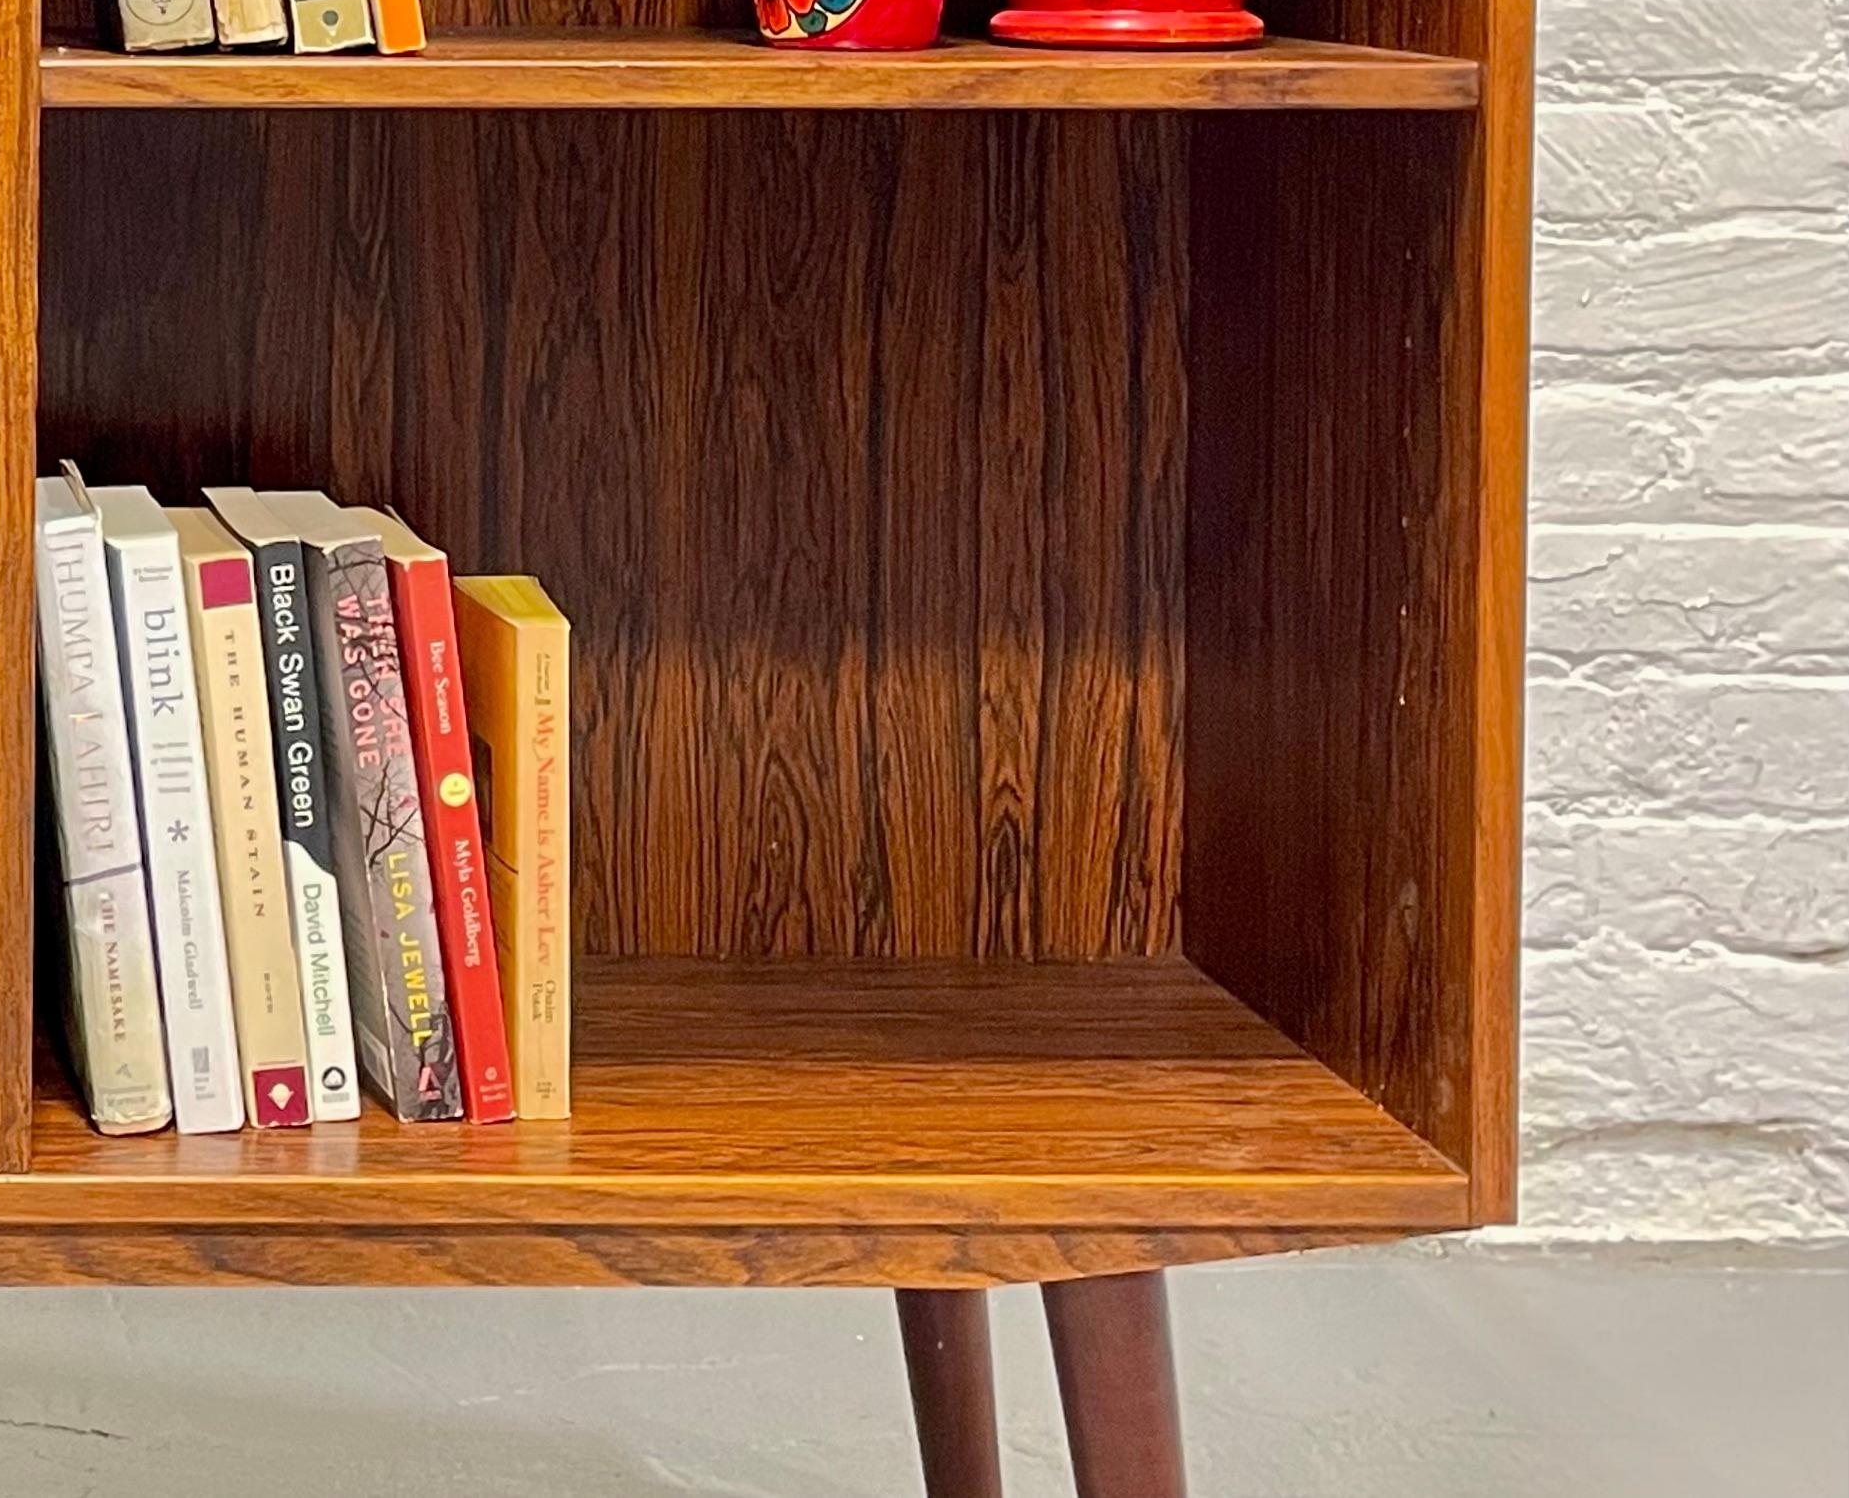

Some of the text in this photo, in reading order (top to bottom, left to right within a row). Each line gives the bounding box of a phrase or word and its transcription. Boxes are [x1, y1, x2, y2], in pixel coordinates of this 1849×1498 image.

[45, 538, 114, 853] JHUMPA LAHIRI
[143, 606, 185, 717] blink
[269, 563, 314, 828] Black Swan Green
[337, 594, 381, 769] WAS GONE
[428, 639, 452, 735] Bee Season
[224, 629, 266, 918] THE HUMAN STAIN
[532, 712, 555, 761] My
[537, 757, 556, 826] Name
[536, 854, 556, 921] Asher
[537, 828, 556, 847] is
[176, 869, 205, 1011] Malcolm Gladwell
[303, 883, 336, 1037] David Mitchell
[388, 850, 433, 1047] LISA JEWELL
[452, 839, 481, 968] Myla Goldberg
[105, 941, 126, 1043] NAMESAKE
